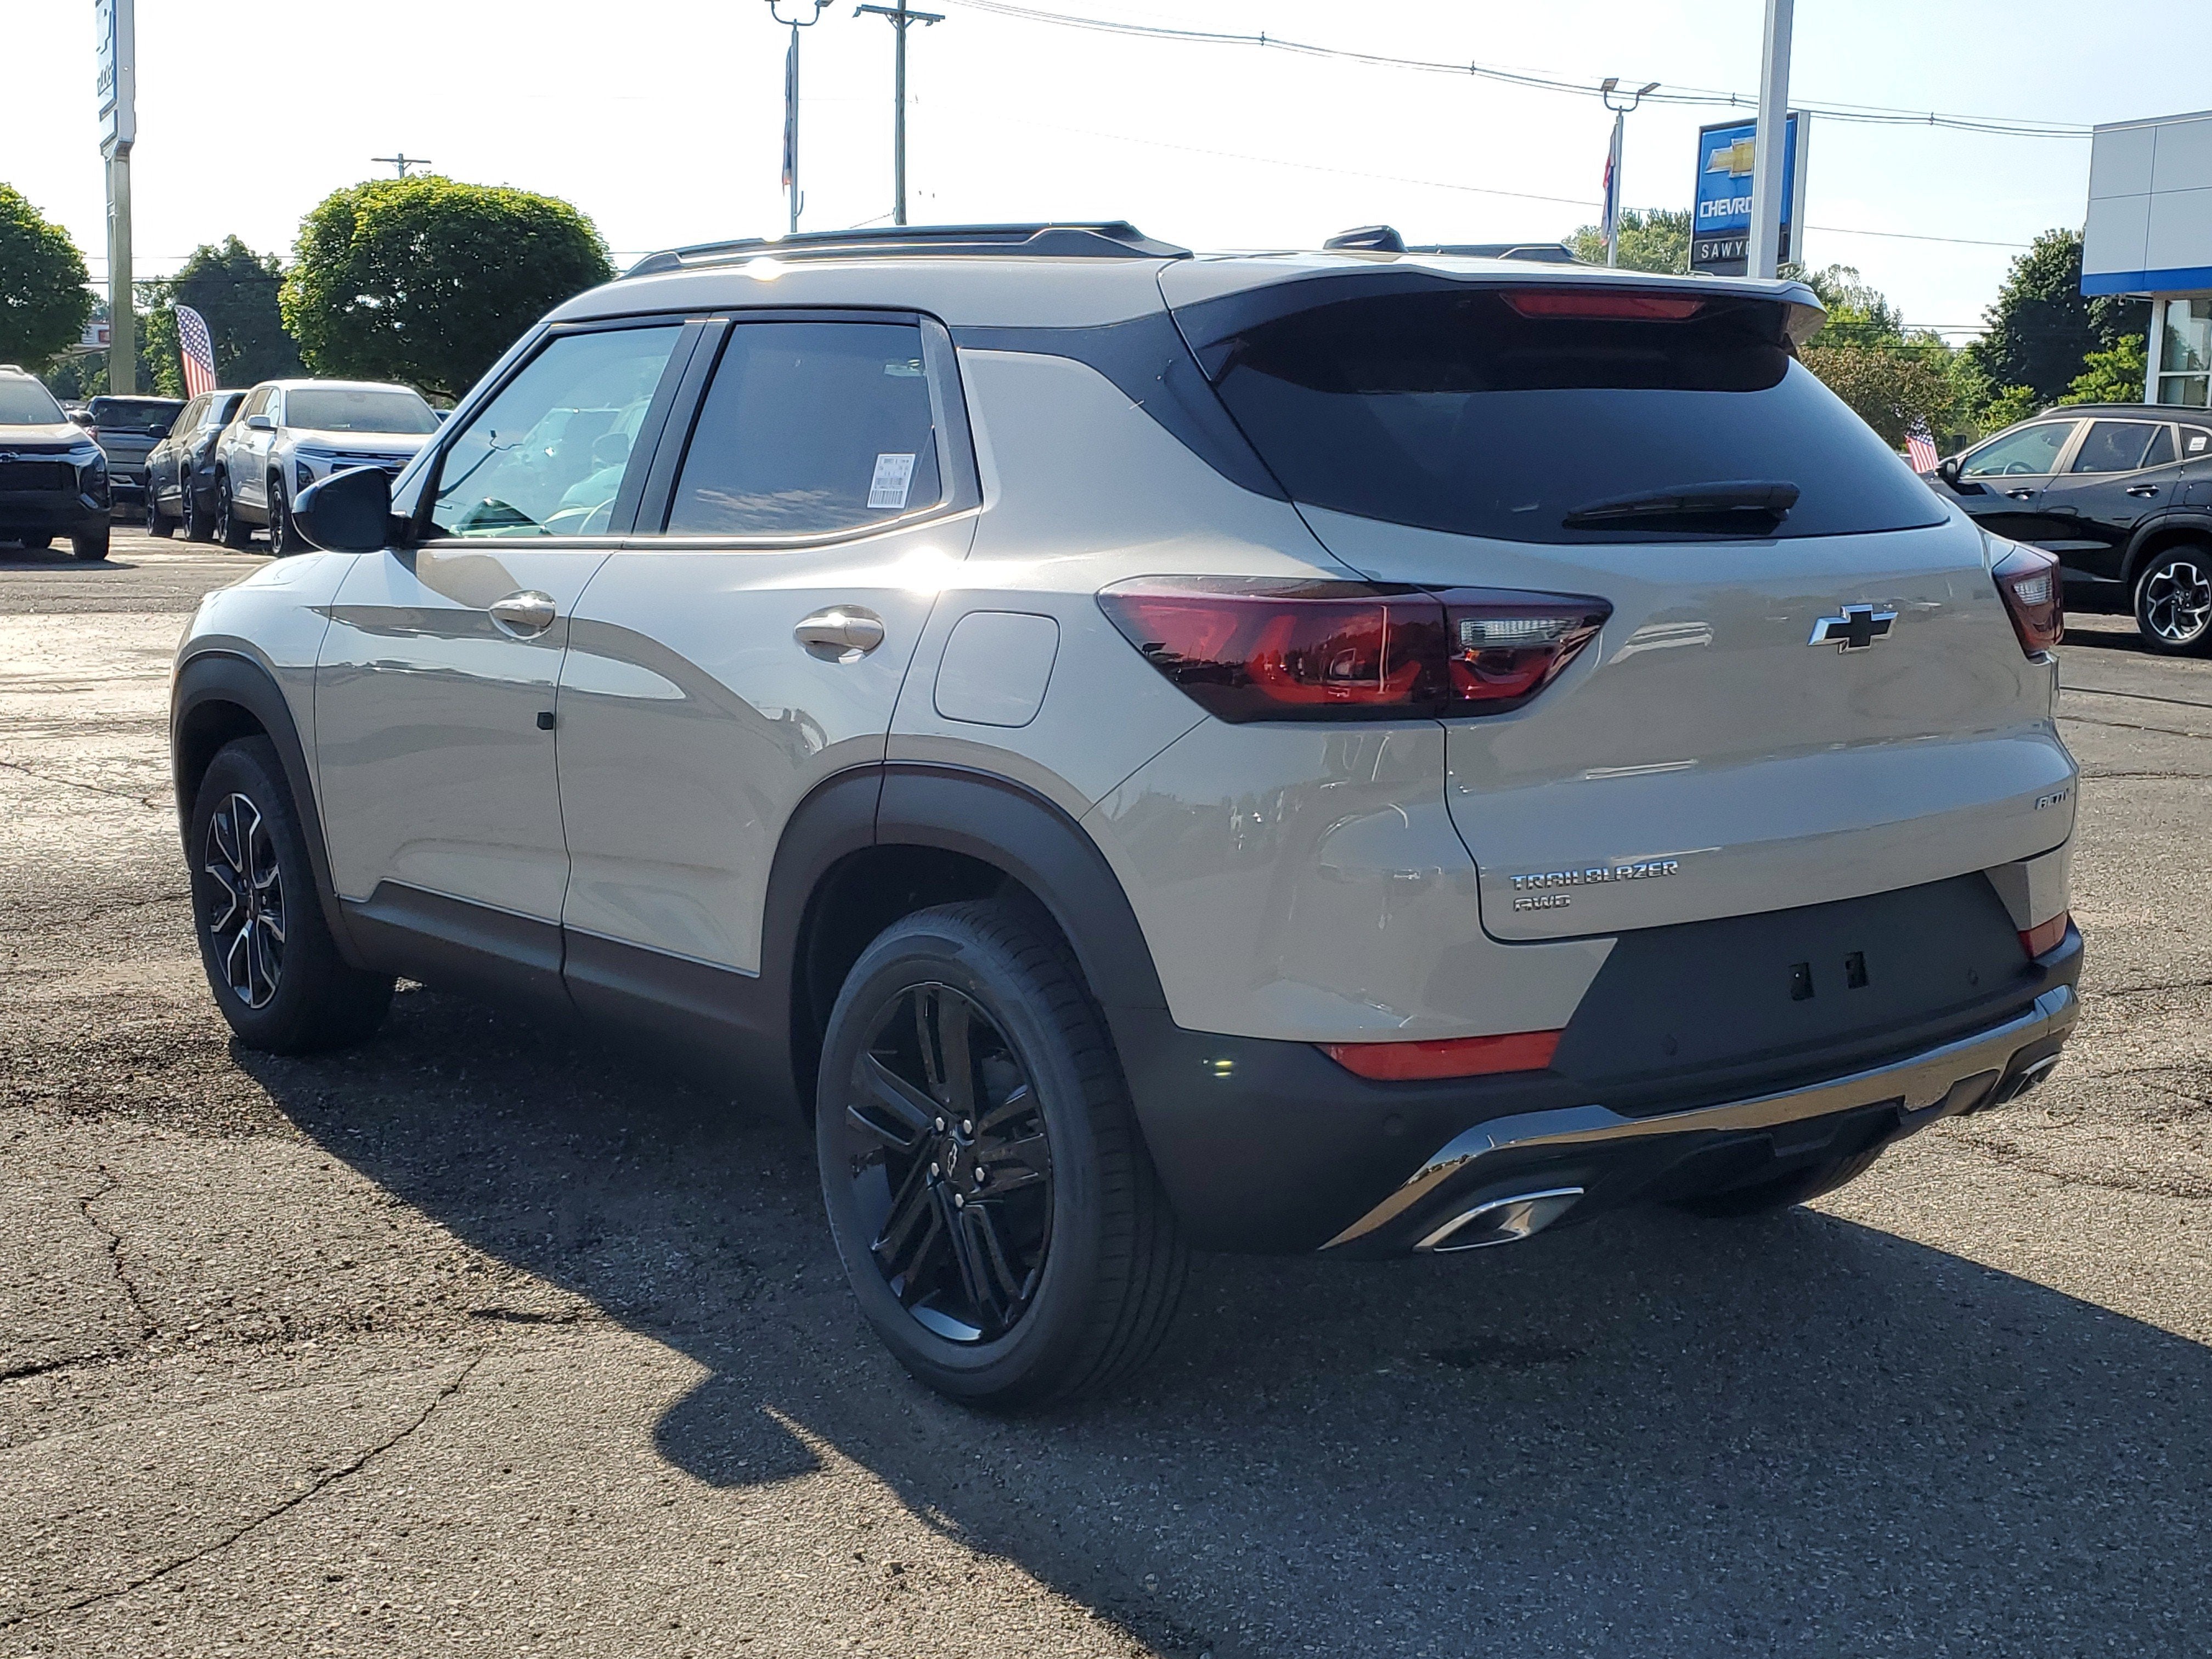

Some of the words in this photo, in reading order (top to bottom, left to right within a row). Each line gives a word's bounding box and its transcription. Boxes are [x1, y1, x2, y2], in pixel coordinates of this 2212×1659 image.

[1700, 196, 1752, 218] CHEVRO
[1510, 860, 1678, 890] TRAILBLAZER
[1514, 894, 1571, 912] AWD
